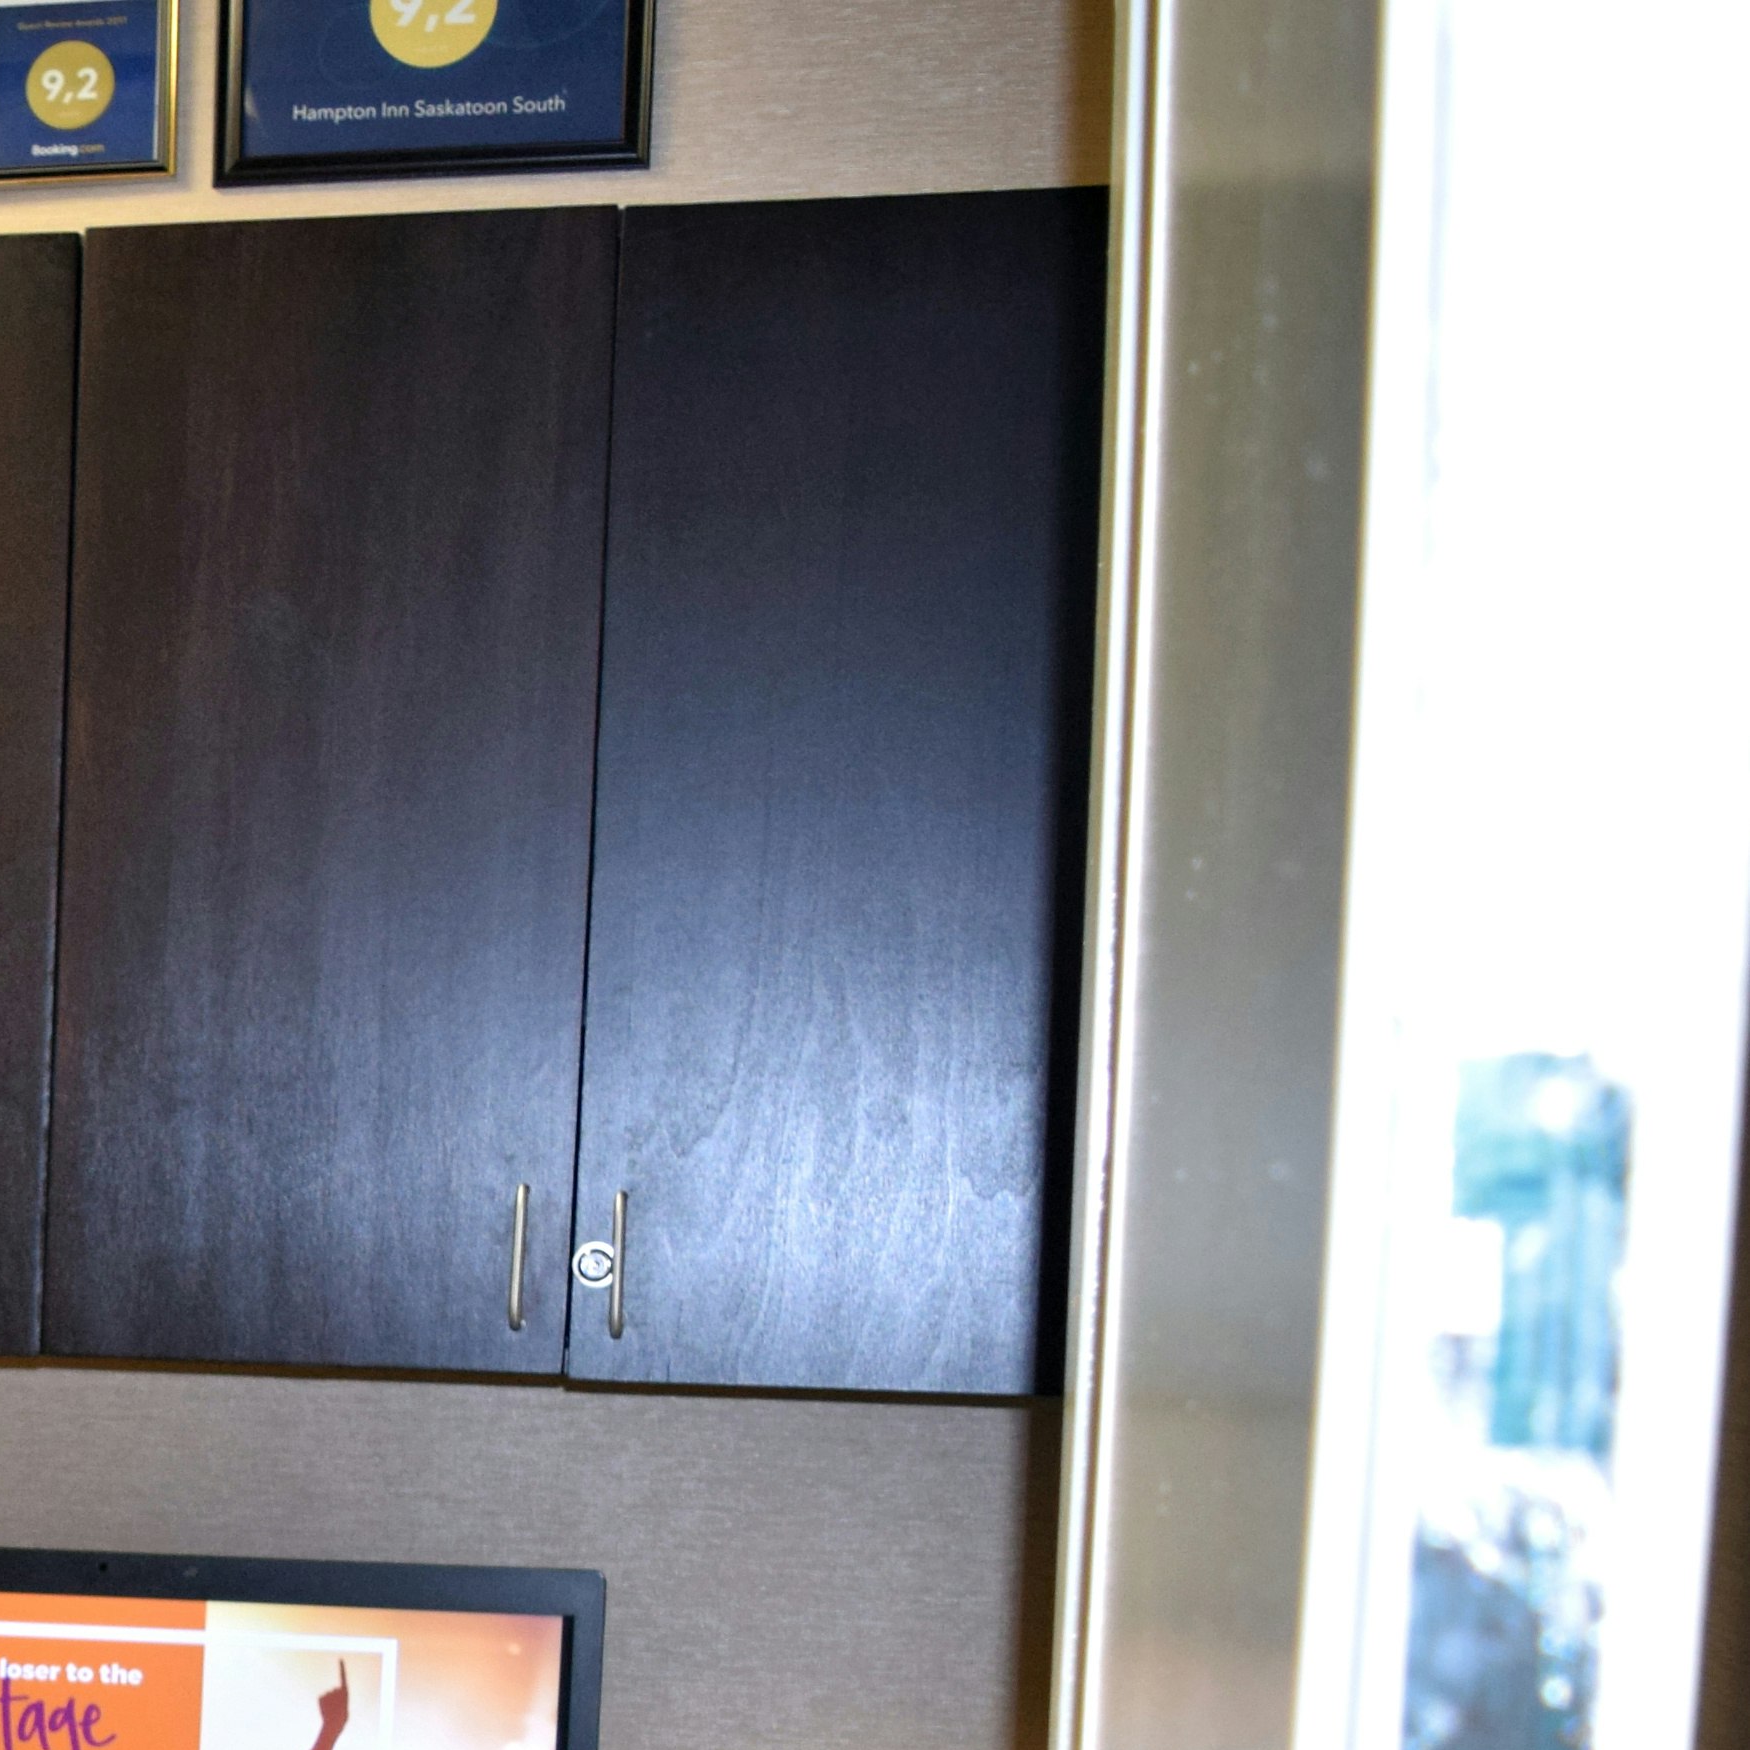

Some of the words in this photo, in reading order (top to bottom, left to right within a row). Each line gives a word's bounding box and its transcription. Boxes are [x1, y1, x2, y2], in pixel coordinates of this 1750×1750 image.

[41, 67, 98, 104] 9,2
[292, 103, 376, 124] Hampton
[381, 101, 409, 118] Inn
[414, 99, 507, 119] Saskatoon
[512, 94, 566, 113] South
[31, 143, 105, 157] Booking.com
[66, 1662, 94, 1683] to
[99, 1663, 143, 1686] the
